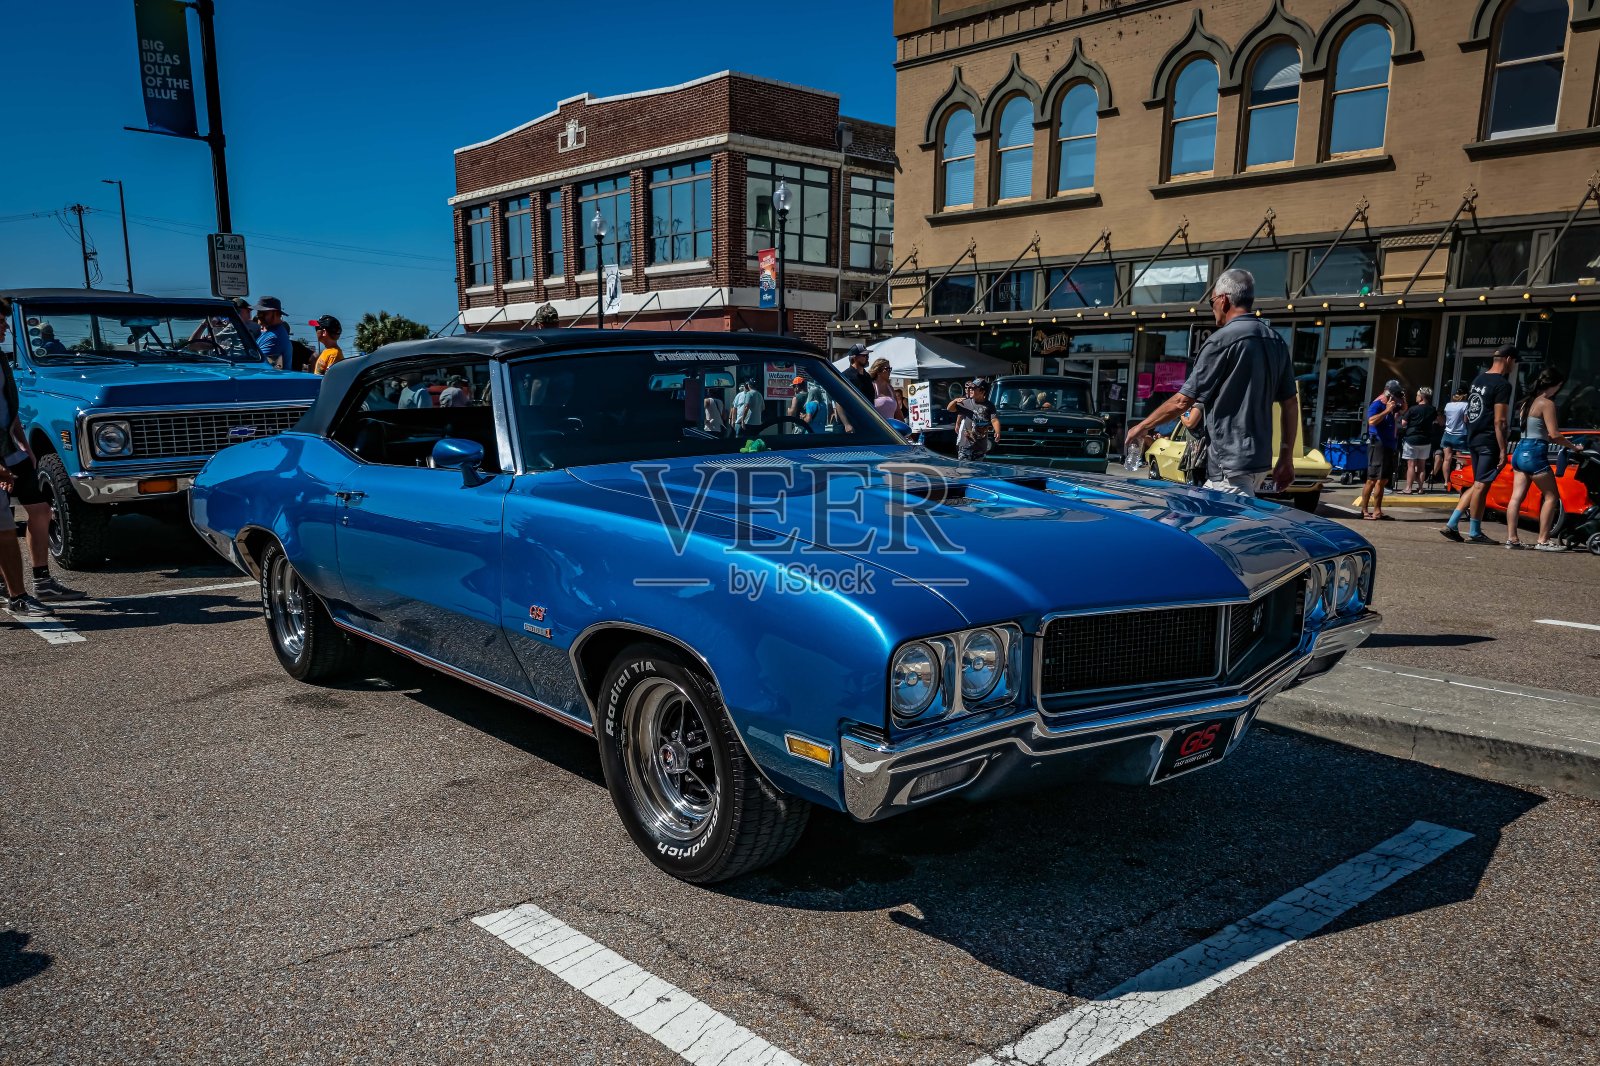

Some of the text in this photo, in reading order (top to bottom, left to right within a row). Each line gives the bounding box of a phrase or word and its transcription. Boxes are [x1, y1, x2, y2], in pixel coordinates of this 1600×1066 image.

[142, 39, 164, 51] BIG
[143, 52, 180, 65] IDEAS
[144, 64, 171, 77] OUT
[145, 76, 190, 90] OF THE
[147, 88, 178, 101] BLUE
[215, 236, 224, 248] 2
[606, 661, 657, 737] Radial T/A
[1180, 723, 1221, 756] GS
